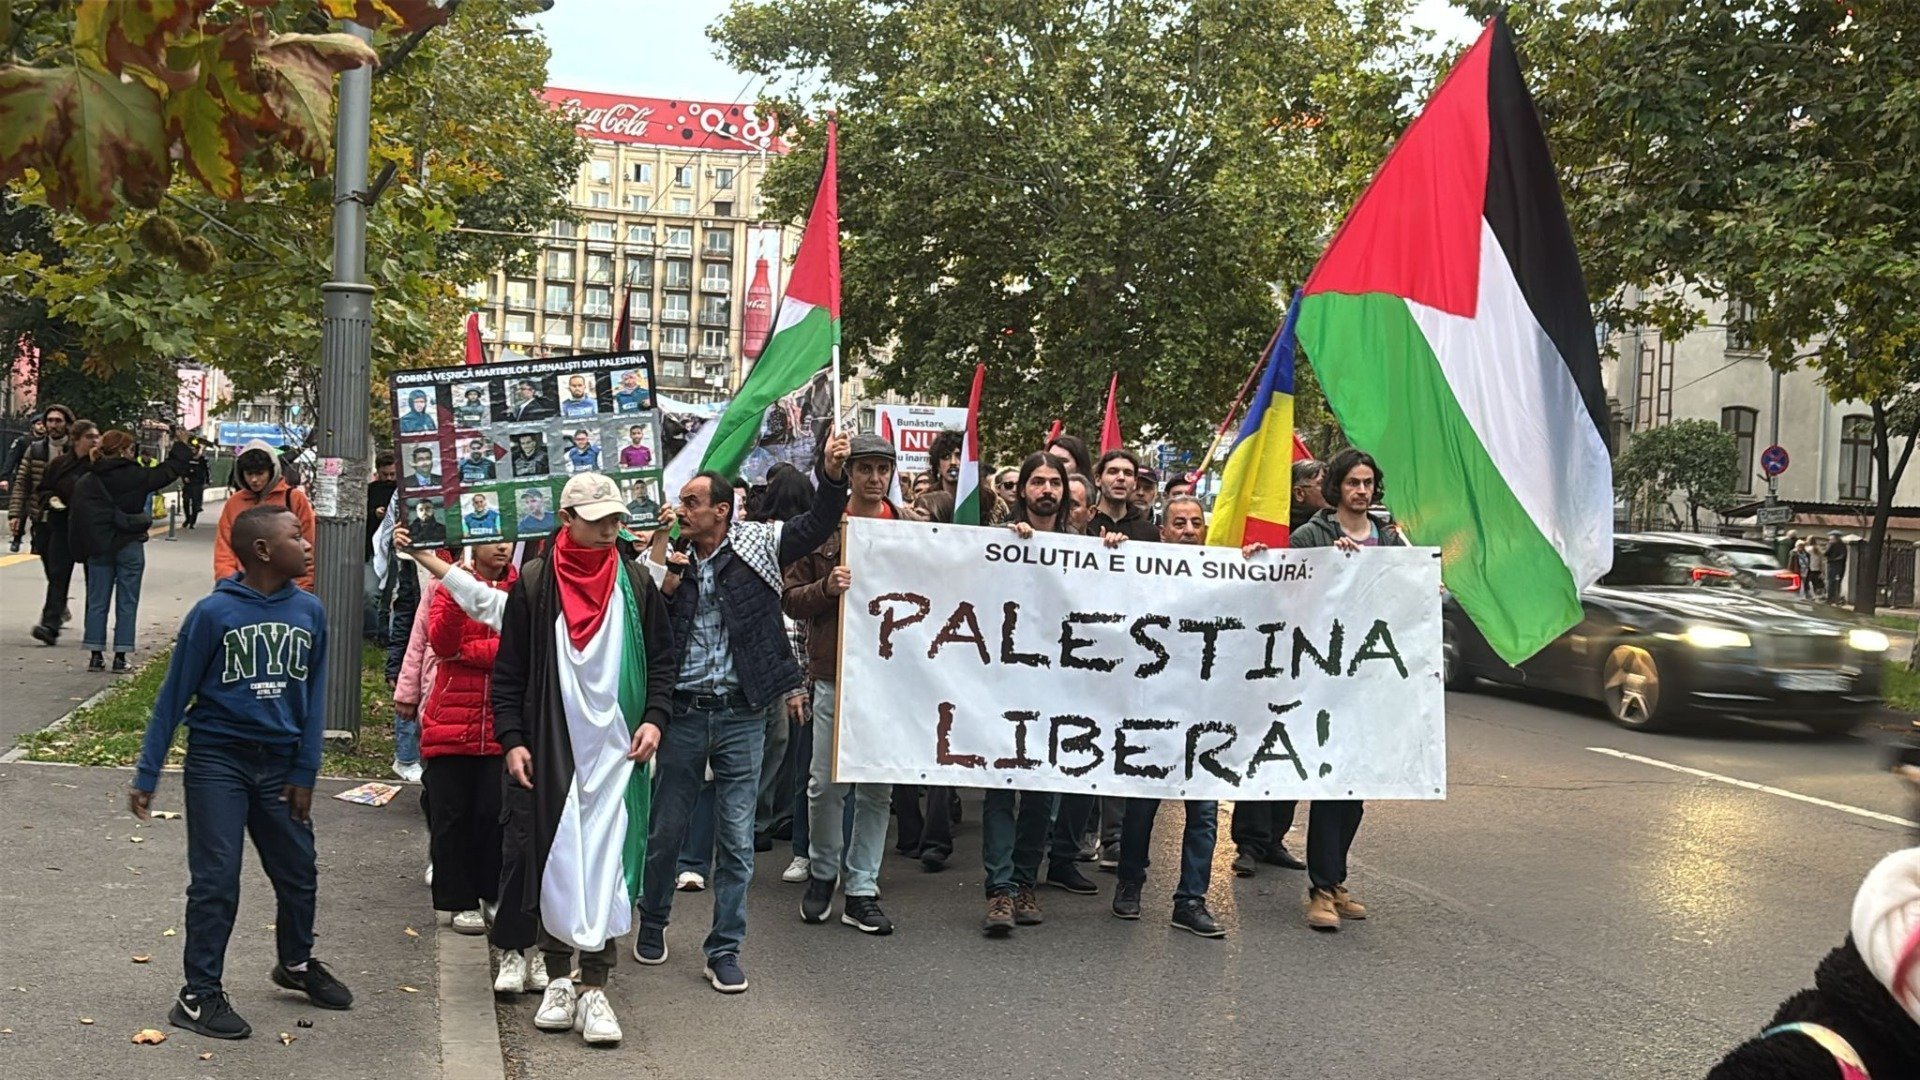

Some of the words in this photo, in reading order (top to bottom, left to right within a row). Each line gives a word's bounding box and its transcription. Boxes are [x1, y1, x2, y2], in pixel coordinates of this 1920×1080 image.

[396, 371, 434, 384] ODIHNĂ
[475, 364, 529, 377] MARTIRILOR
[582, 359, 598, 369] DIN
[599, 355, 648, 368] PALESTINA
[905, 431, 937, 449] NU
[984, 542, 1100, 575] SOLUȚIA
[1108, 553, 1126, 573] E
[1135, 556, 1193, 577] UNA
[1201, 557, 1314, 582] SINGURĂ:
[222, 622, 312, 683] NYC
[868, 591, 1409, 681] PALESTINA
[935, 700, 1333, 787] LIBERĂ!
